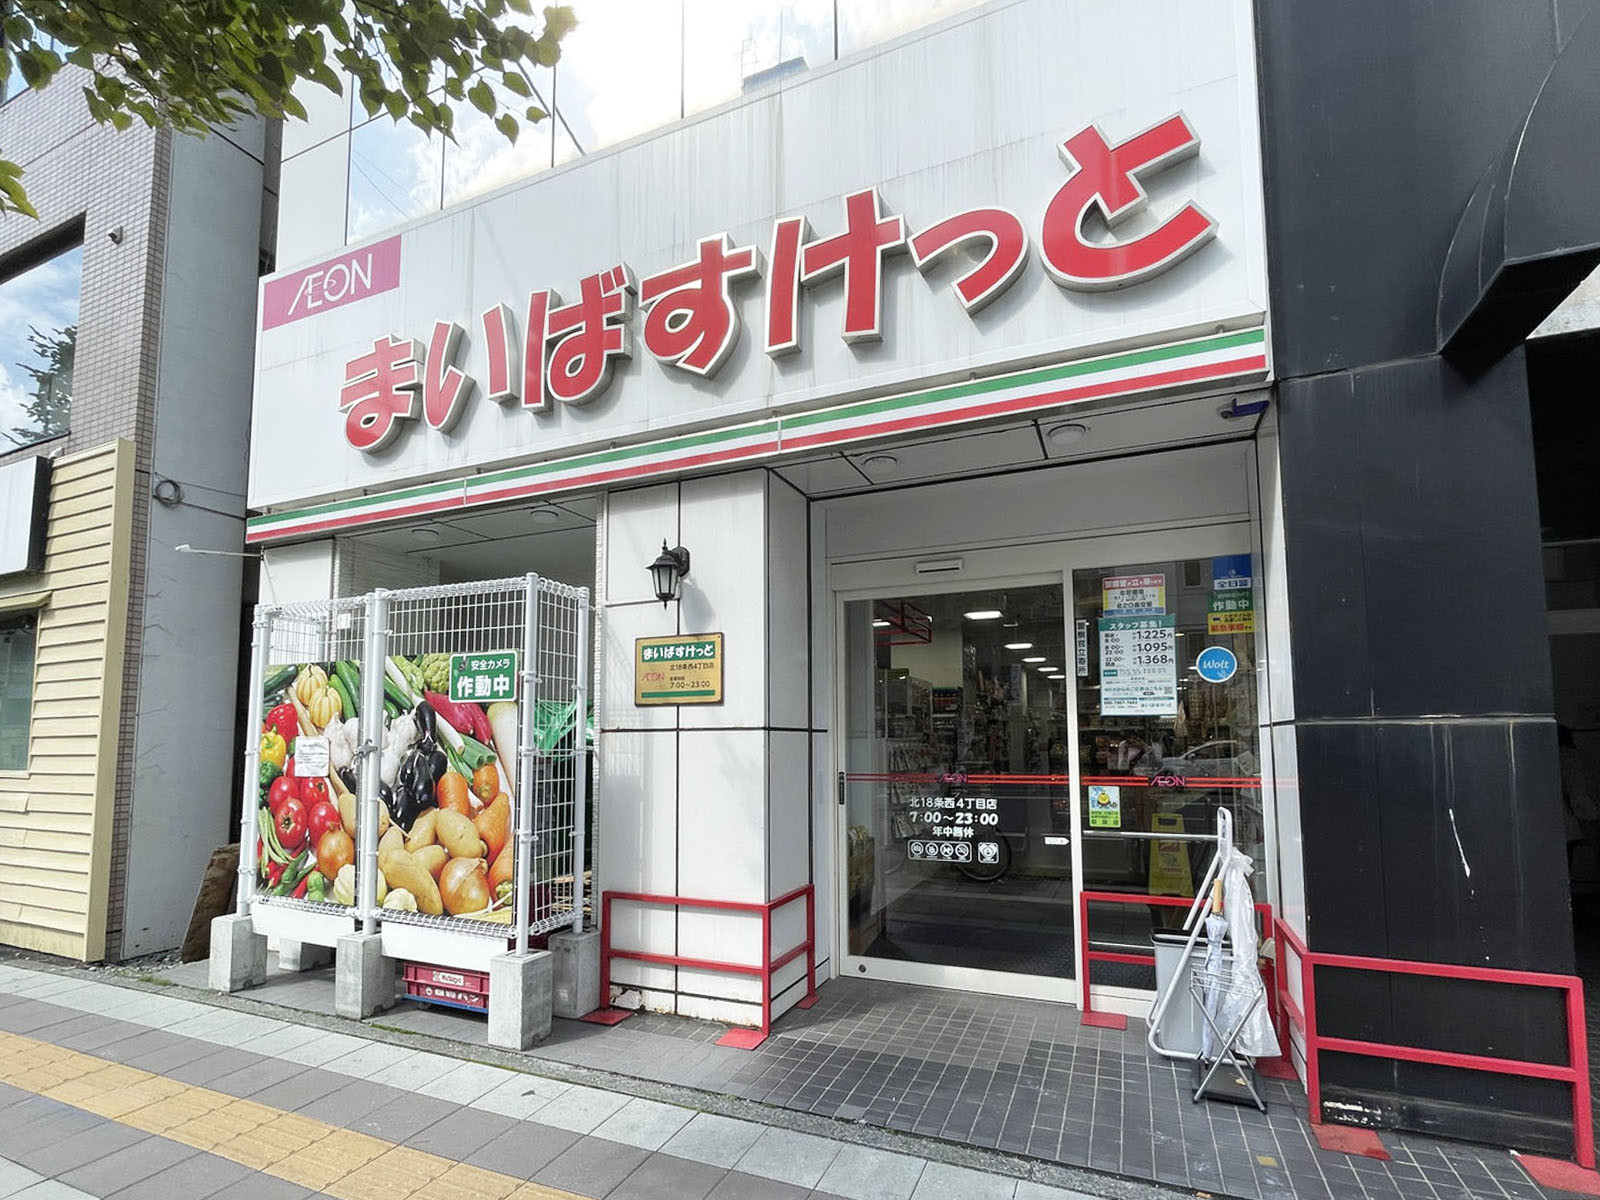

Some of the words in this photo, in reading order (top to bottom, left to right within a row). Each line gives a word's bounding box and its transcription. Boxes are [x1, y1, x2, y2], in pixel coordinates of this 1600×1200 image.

[339, 110, 1220, 455] まいばすけっと
[643, 644, 714, 660] まいばすけっと
[471, 659, 510, 671] 安全カメラ
[1203, 658, 1230, 669] Wolt
[457, 674, 510, 698] 作動中
[909, 797, 998, 809] 北18条西4丁目店
[932, 826, 975, 838] 年中無休
